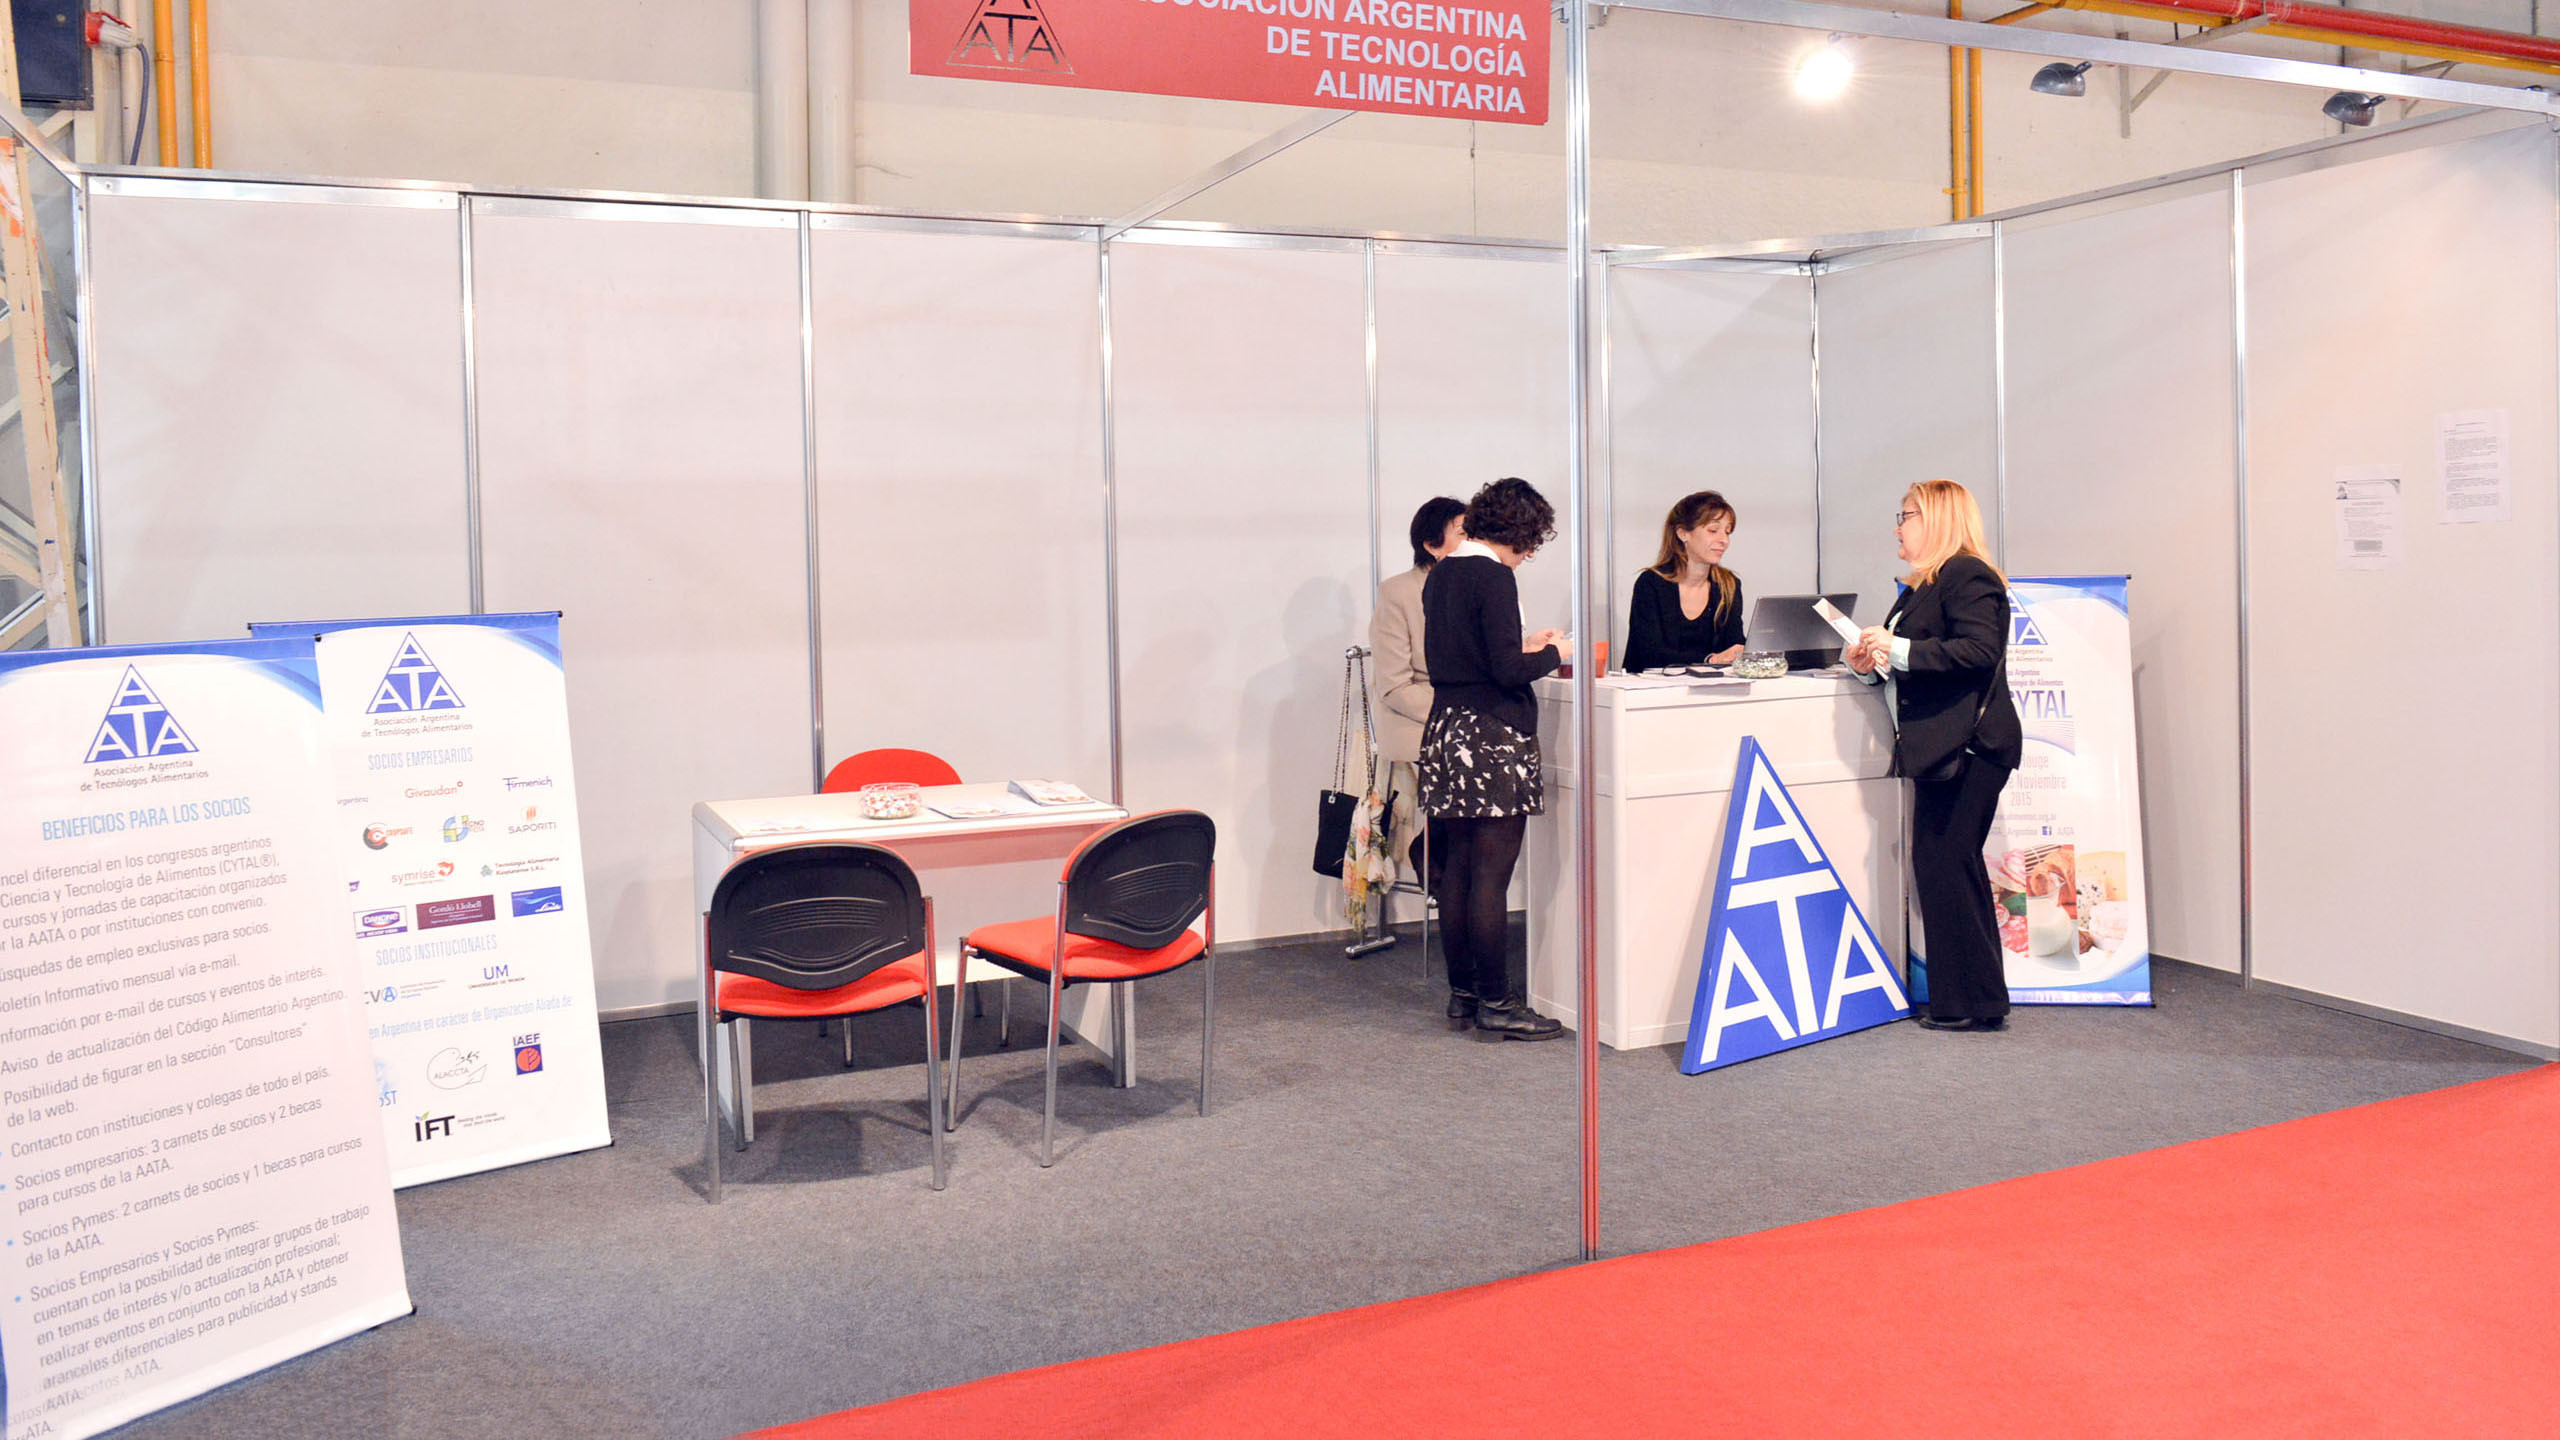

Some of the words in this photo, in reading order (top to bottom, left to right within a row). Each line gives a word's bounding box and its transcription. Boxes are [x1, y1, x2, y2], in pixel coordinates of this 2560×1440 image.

[1344, 0, 1527, 41] ARGENTINA
[1267, 25, 1311, 57] DE
[1320, 31, 1526, 77] TECNOLOGÍA
[1314, 70, 1526, 114] ALIMENTARIA
[2037, 679, 2064, 687] Alimentos
[373, 716, 418, 726] Asociación
[420, 713, 460, 724] Argentina
[2010, 690, 2073, 719] YTAL
[361, 730, 371, 738] de
[374, 727, 420, 737] Tecnólogos
[421, 724, 473, 733] Alimentarios
[93, 764, 145, 777] Asociación
[147, 760, 194, 773] Argentina
[368, 752, 405, 770] SOCIOS
[406, 746, 474, 769] EMPRESARIOS
[80, 782, 93, 792] de
[94, 777, 149, 790] Tecnólogos
[150, 770, 209, 784] Alimentarios
[404, 784, 457, 799] Givaudan
[502, 776, 553, 793] Firmenich
[2010, 792, 2033, 807] 2015
[42, 812, 126, 841] BENEFICIOS
[127, 807, 169, 829] PARA
[172, 803, 200, 824] LOS
[199, 796, 251, 820] SOCIOS
[508, 821, 556, 834] SAPORITI
[32, 859, 103, 882] diferencial
[105, 859, 122, 871] en
[124, 855, 144, 869] los
[146, 847, 209, 865] congresos
[211, 837, 272, 857] argentinos
[391, 868, 435, 885] symrise
[2, 912, 47, 930] cursos
[49, 911, 59, 925] y
[60, 900, 118, 924] jornadas
[120, 896, 137, 910] de
[139, 884, 217, 908] capacitación
[219, 872, 287, 895] organizados
[53, 889, 62, 903] y
[63, 876, 134, 898] Tecnología
[136, 872, 153, 887] de
[155, 865, 217, 884] Alimentos
[10, 935, 24, 950] la
[28, 927, 66, 947] AATA
[68, 929, 77, 940] o
[80, 924, 102, 941] por
[104, 910, 185, 934] instituciones
[186, 906, 209, 919] con
[211, 895, 266, 915] convenio.
[66, 955, 83, 970] de
[86, 947, 134, 966] empleo
[136, 935, 201, 956] exclusivas
[202, 930, 230, 947] para
[232, 922, 272, 939] socios.
[376, 946, 413, 966] SOCIOS
[414, 934, 498, 960] INSTITUCIONALES
[44, 979, 120, 1004] Informativo
[122, 965, 175, 989] mensual
[178, 963, 197, 978] vía
[199, 954, 240, 973] e-mail.
[484, 964, 509, 980] UM
[80, 1013, 101, 1030] por
[103, 1001, 145, 1024] e-mail
[148, 998, 165, 1013] de
[166, 991, 207, 1009] cursos
[209, 989, 217, 1002] y
[218, 979, 266, 998] eventos
[268, 974, 282, 988] de
[285, 967, 327, 984] interés.
[0, 1057, 39, 1076] Aviso
[46, 1050, 64, 1065] de
[66, 1031, 151, 1061] actualización
[153, 1024, 174, 1041] del
[175, 1017, 219, 1036] Código
[221, 1000, 289, 1026] Alimentario
[291, 989, 347, 1010] Argentino.
[512, 1033, 541, 1047] IAEF
[3, 1075, 79, 1106] Posibilidad
[80, 1072, 99, 1088] de
[101, 1063, 144, 1084] figurar
[146, 1059, 163, 1072] en
[165, 1054, 178, 1068] la
[180, 1043, 226, 1064] sección
[7, 1112, 25, 1128] de
[28, 1108, 42, 1123] la
[44, 1099, 78, 1118] web.
[11, 1133, 73, 1158] Contacto
[75, 1126, 100, 1141] con
[103, 1104, 184, 1134] instituciones
[186, 1101, 194, 1116] y
[196, 1089, 243, 1110] colegas
[245, 1083, 261, 1097] de
[262, 1076, 291, 1093] todo
[291, 1071, 302, 1086] el
[304, 1066, 329, 1085] país.
[14, 1169, 61, 1191] Socios
[64, 1144, 149, 1177] empresarios:
[150, 1139, 160, 1154] 3
[162, 1129, 209, 1150] carnets
[211, 1123, 227, 1137] de
[229, 1113, 267, 1132] socios
[268, 1111, 276, 1124] y
[278, 1105, 289, 1119] 2
[288, 1099, 322, 1116] becas
[18, 1194, 49, 1216] para
[50, 1181, 97, 1203] cursos
[99, 1174, 117, 1190] de
[119, 1170, 132, 1184] la
[135, 1158, 174, 1180] AATA.
[22, 1223, 69, 1246] Socios
[71, 1208, 119, 1232] Pymes:
[121, 1201, 131, 1217] 2
[133, 1190, 181, 1213] carnets
[183, 1184, 200, 1199] de
[202, 1173, 241, 1193] socios
[242, 1170, 250, 1184] y
[253, 1164, 259, 1177] 1
[263, 1156, 298, 1175] becas
[299, 1148, 325, 1167] para
[327, 1138, 362, 1156] cursos
[26, 1252, 43, 1268] de
[46, 1247, 61, 1261] la
[64, 1235, 104, 1256] AATA.
